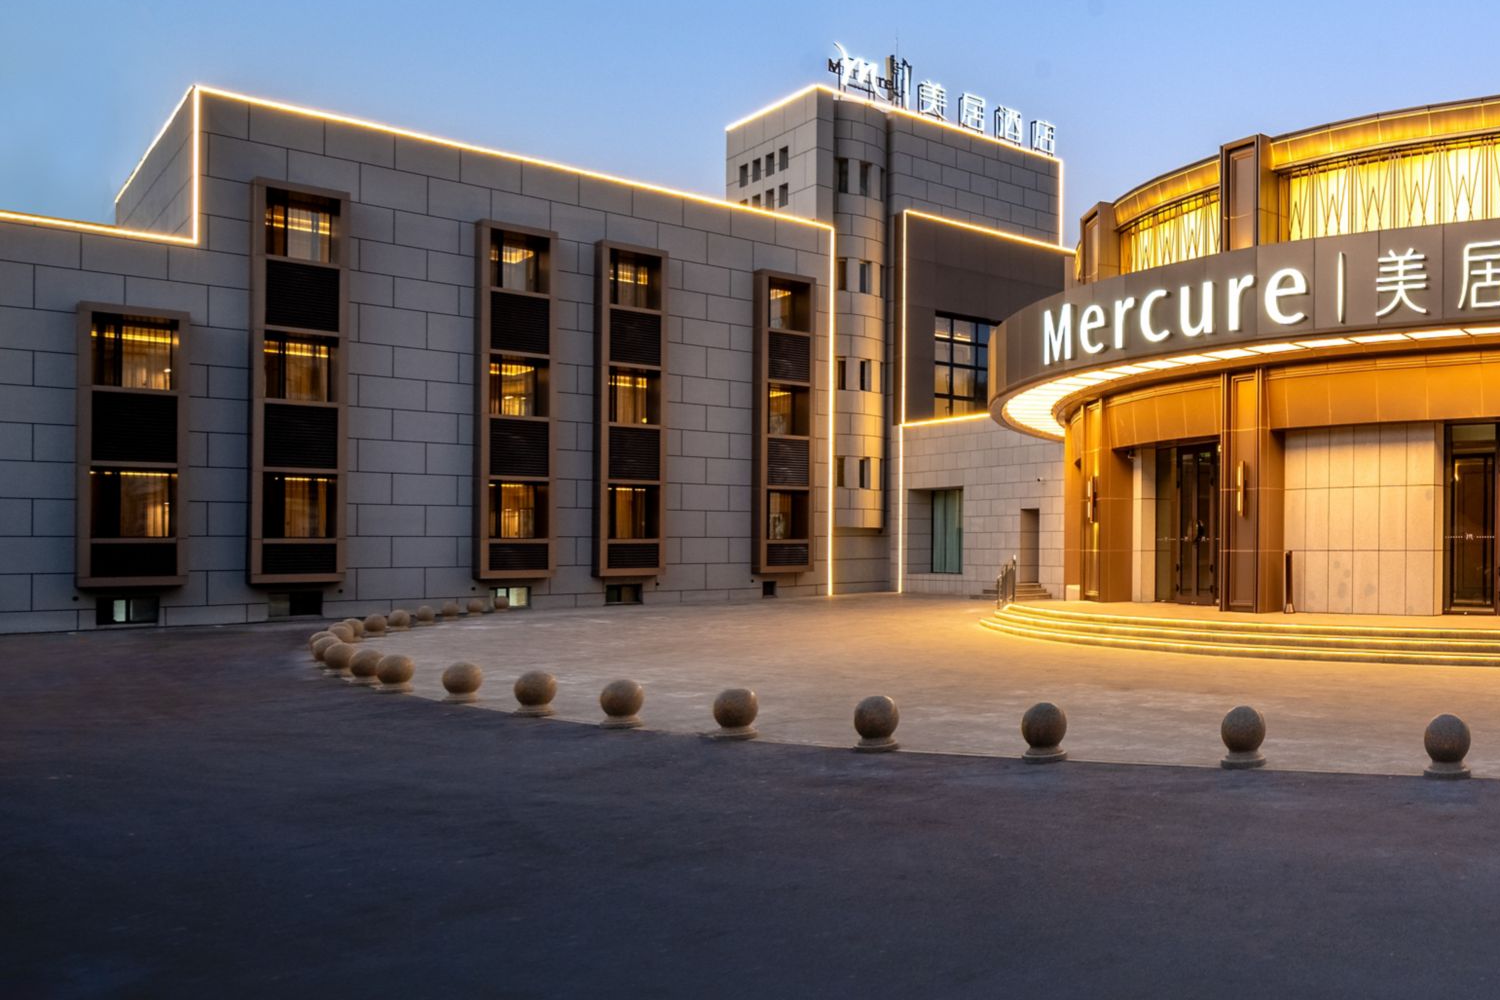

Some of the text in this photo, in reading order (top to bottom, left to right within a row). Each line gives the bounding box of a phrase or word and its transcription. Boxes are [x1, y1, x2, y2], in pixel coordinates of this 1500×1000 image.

[919, 79, 1056, 154] 美居酒店
[1043, 266, 1309, 366] Mercure
